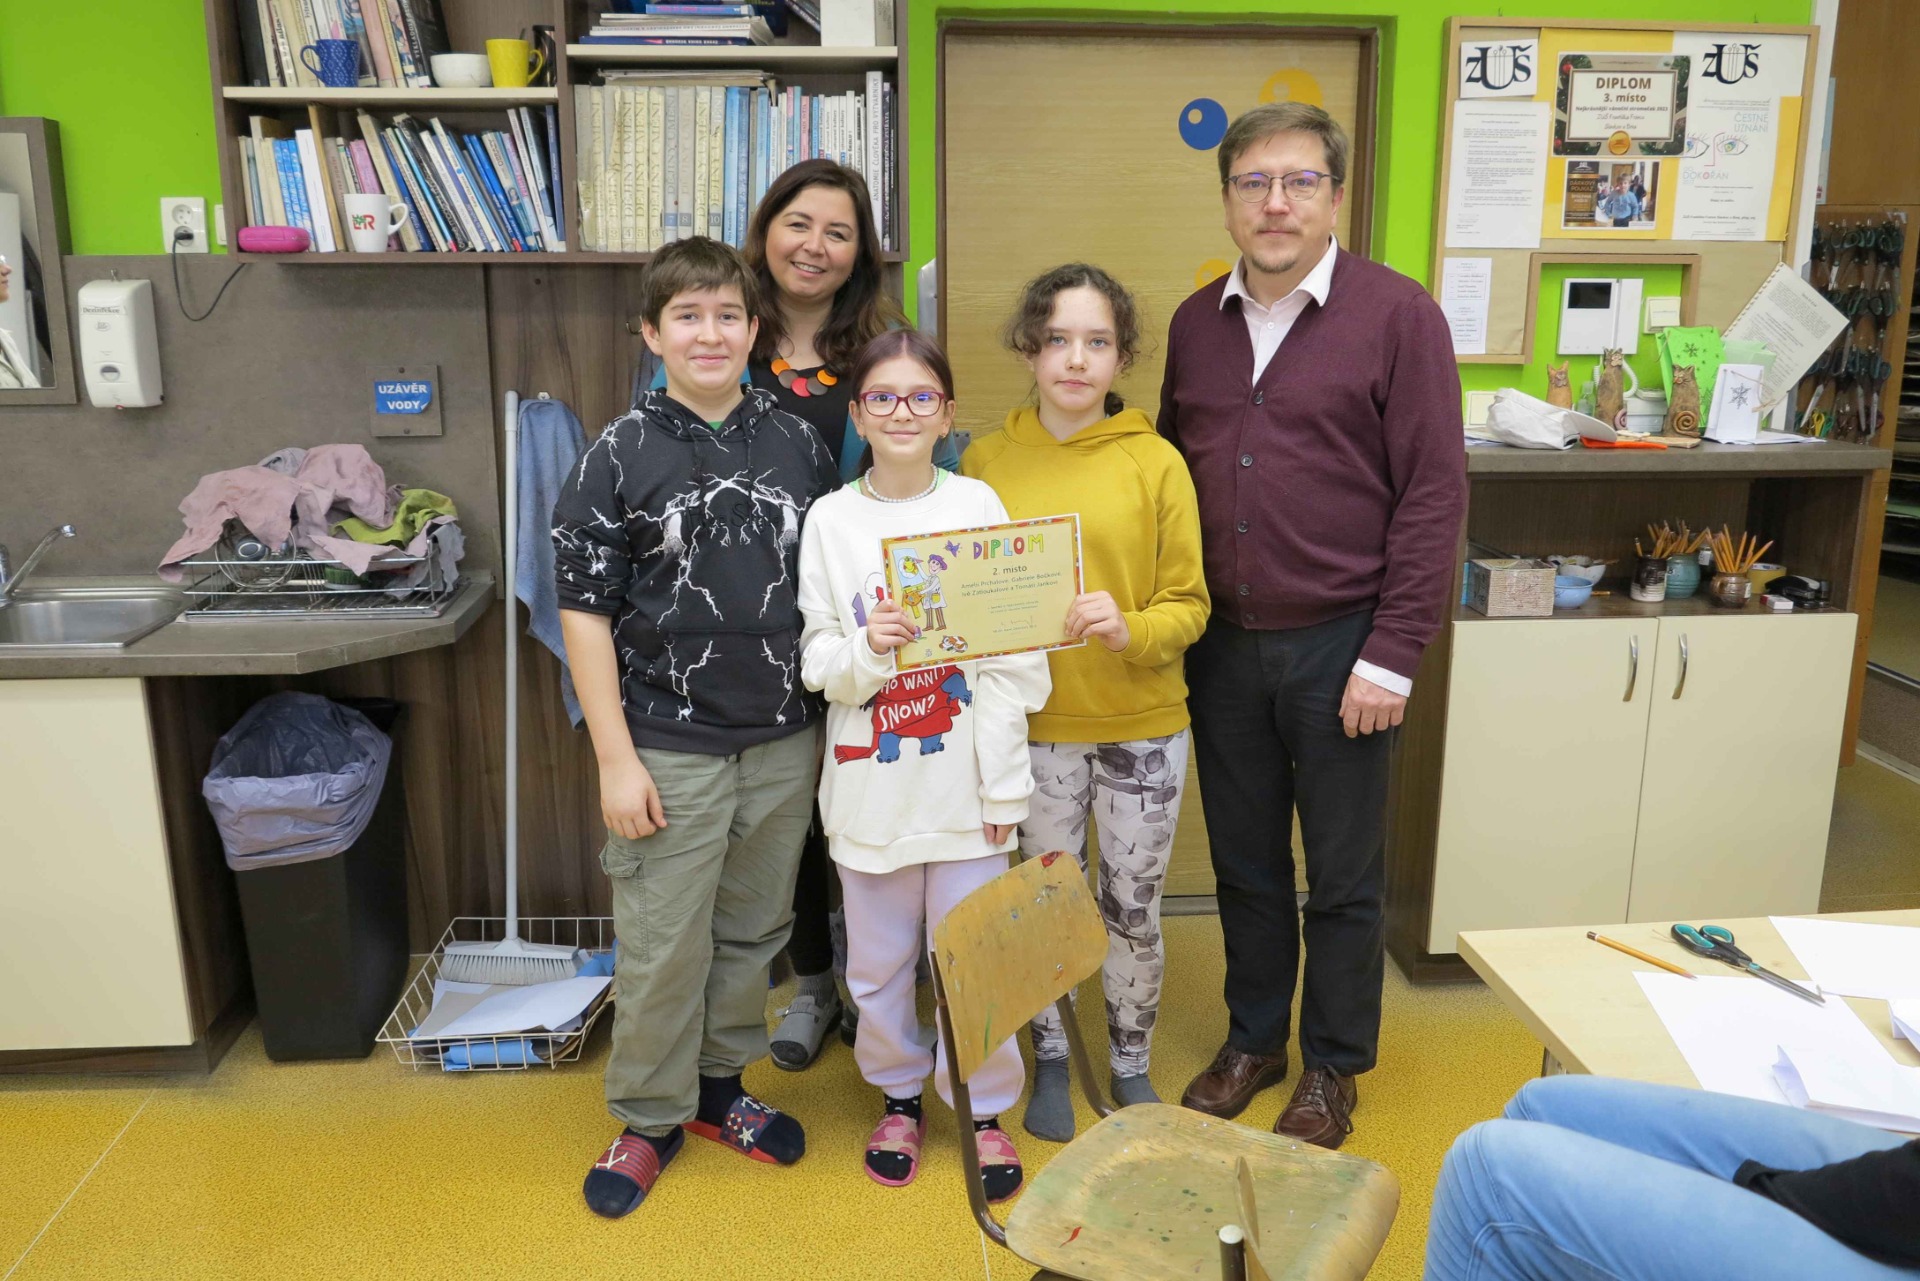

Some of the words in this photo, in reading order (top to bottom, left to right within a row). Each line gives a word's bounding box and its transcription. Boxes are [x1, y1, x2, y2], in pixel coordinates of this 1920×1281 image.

[1596, 77, 1652, 89] DIPLOM
[1604, 92, 1612, 102] 3.
[1616, 92, 1646, 102] místo
[378, 382, 428, 394] UZÁVĚR
[386, 400, 420, 410] VODY
[973, 534, 1044, 560] DIPLOM
[879, 694, 936, 732] SNOW?
